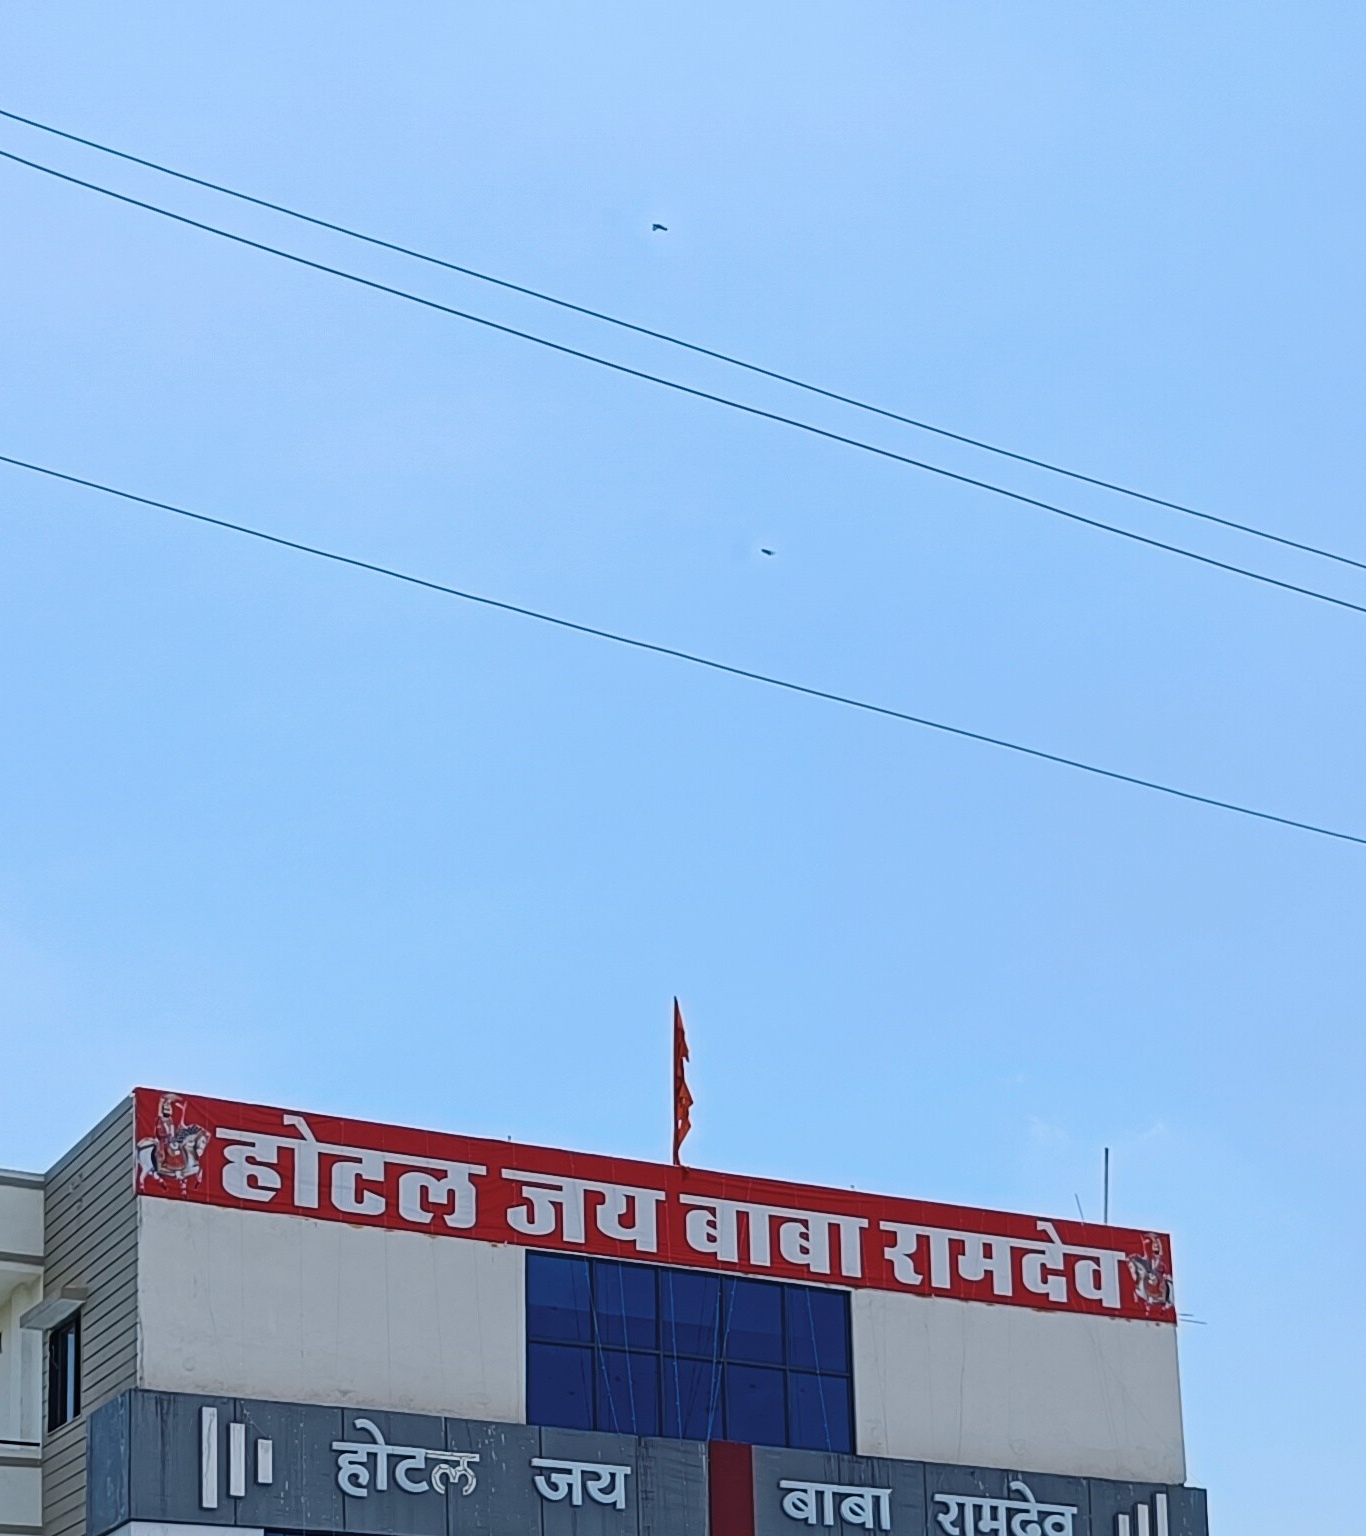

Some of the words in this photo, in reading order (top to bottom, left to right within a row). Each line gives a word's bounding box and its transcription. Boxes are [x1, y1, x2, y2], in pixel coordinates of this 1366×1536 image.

[215, 1114, 487, 1228] होटल
[501, 1168, 666, 1252] जय
[679, 1194, 869, 1278] बाबा
[879, 1220, 1126, 1309] रामदेव
[332, 1418, 480, 1497] होटल
[531, 1457, 631, 1509] जय
[779, 1479, 892, 1531] बाबा
